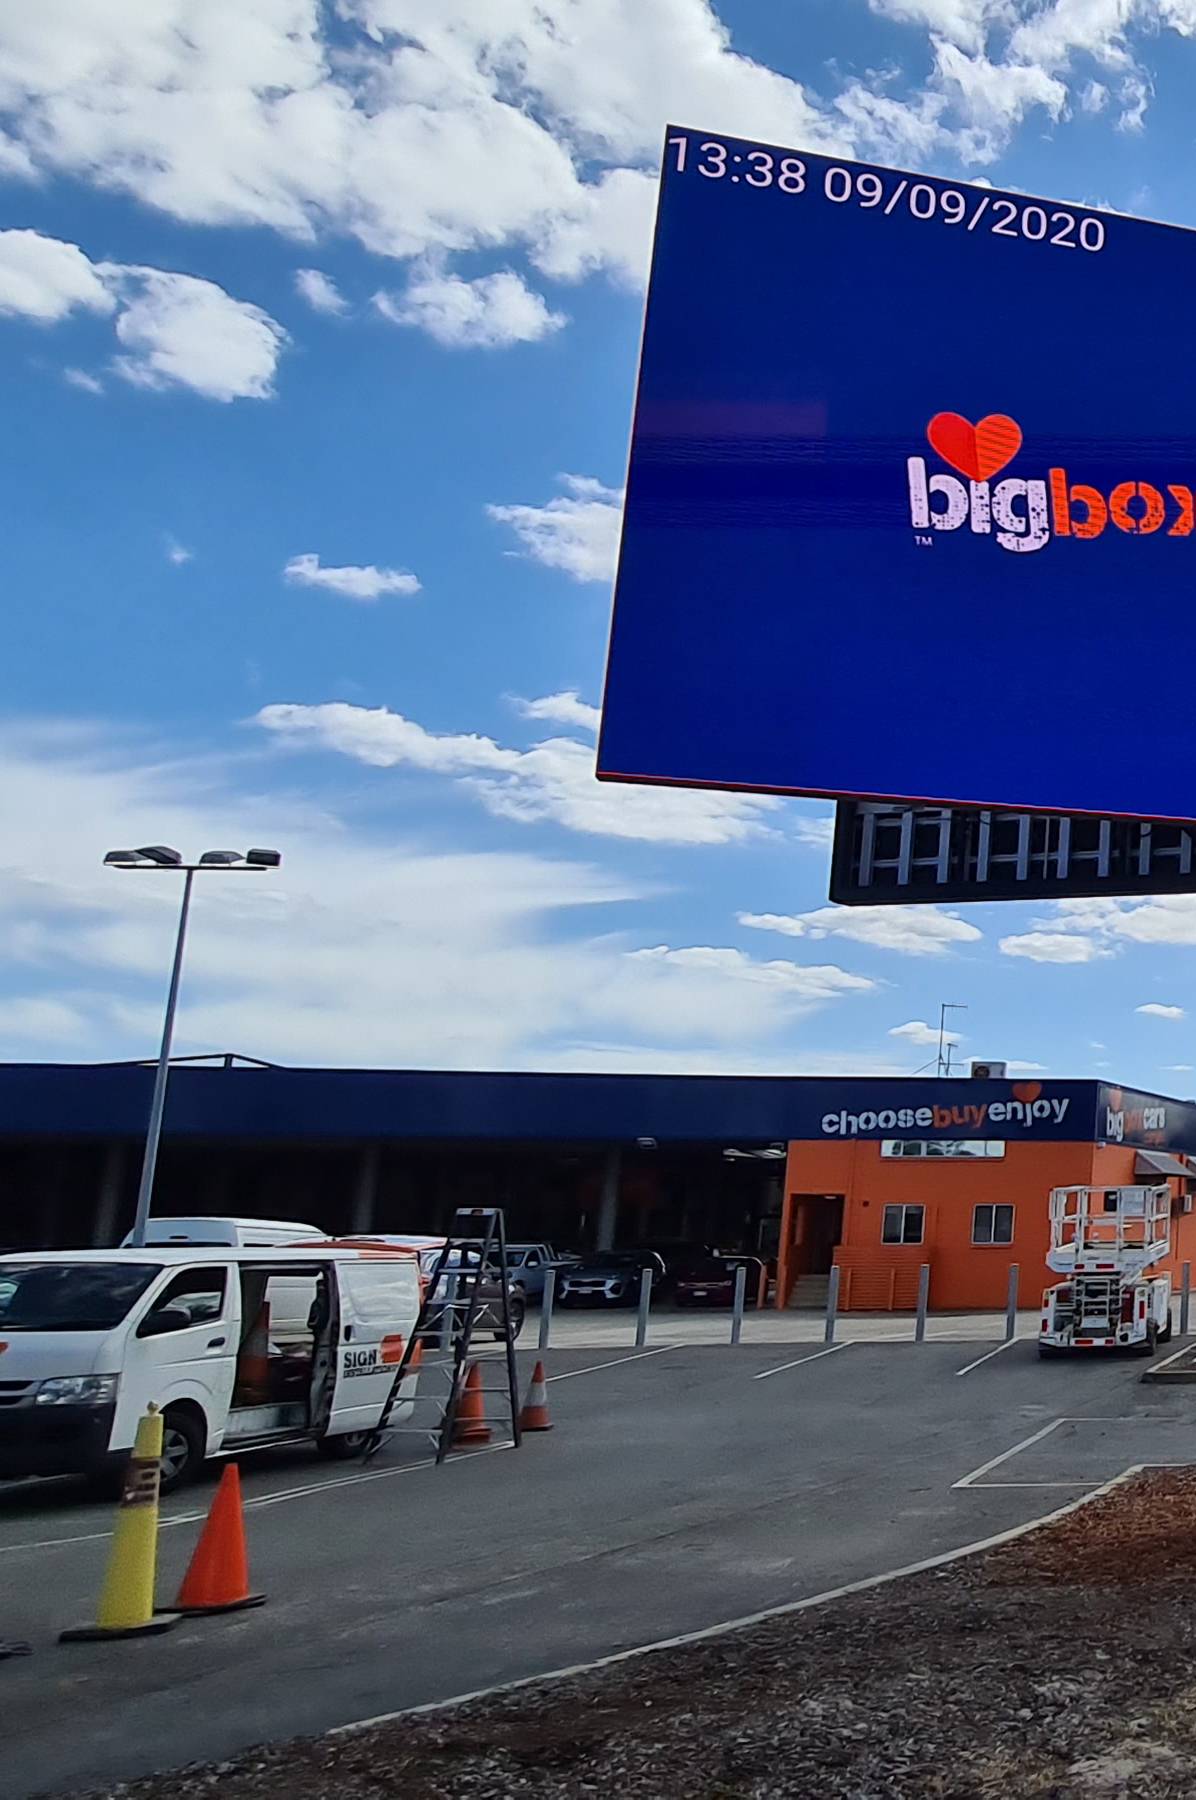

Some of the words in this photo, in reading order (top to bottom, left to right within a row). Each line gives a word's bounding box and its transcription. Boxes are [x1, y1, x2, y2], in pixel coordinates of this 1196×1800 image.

[668, 136, 807, 194] 13:38
[824, 167, 1106, 252] 09/09/2020
[343, 1349, 377, 1368] SIGN
